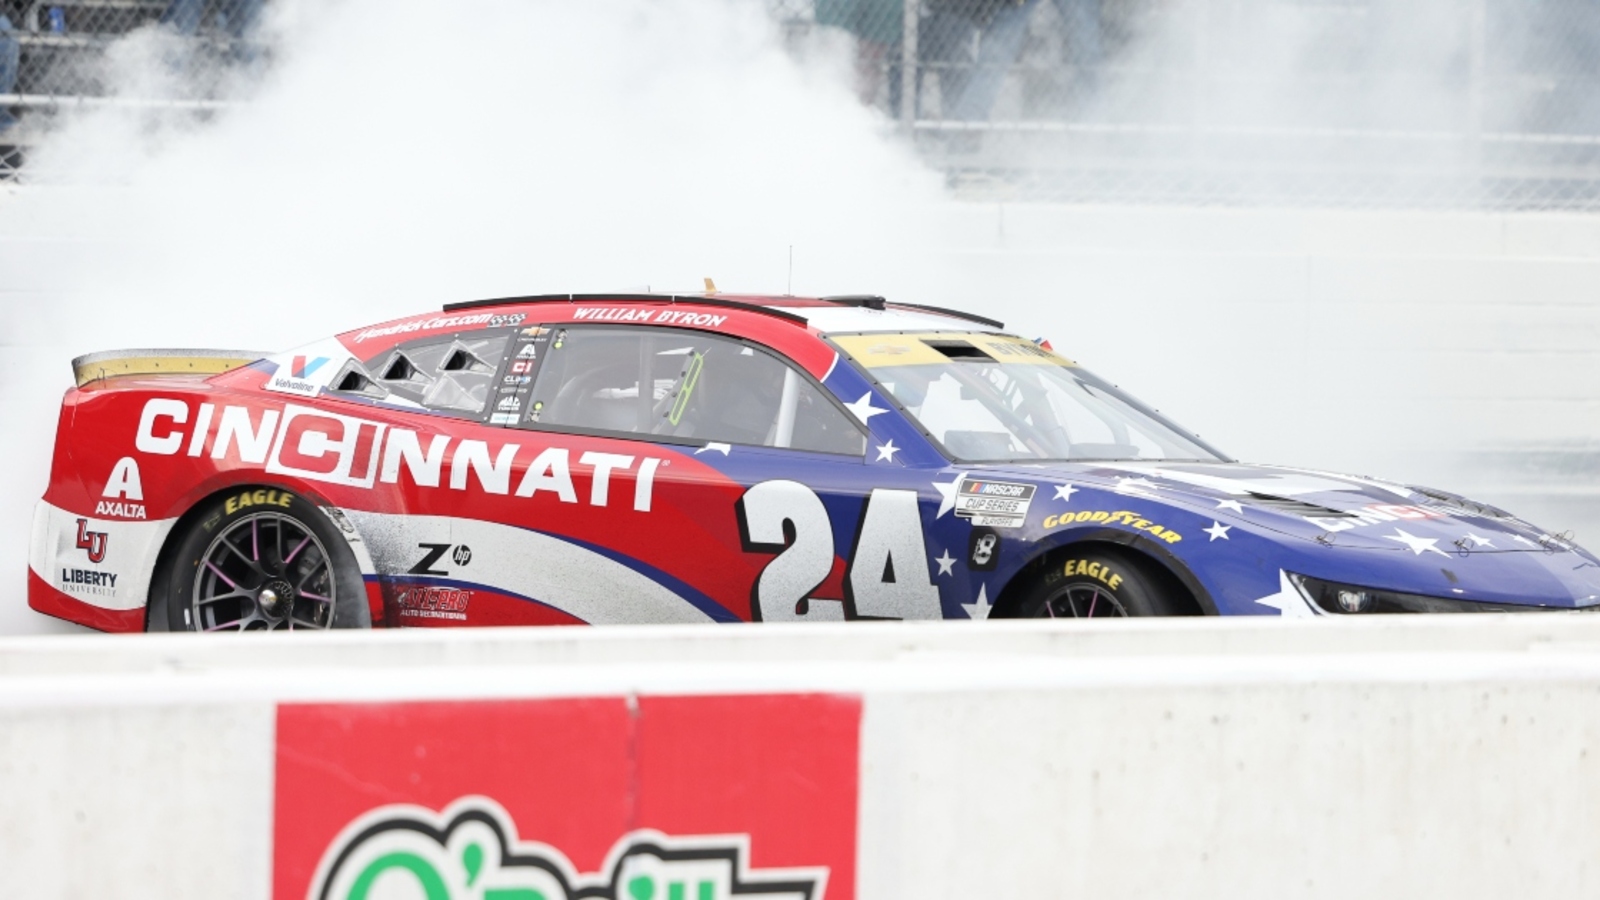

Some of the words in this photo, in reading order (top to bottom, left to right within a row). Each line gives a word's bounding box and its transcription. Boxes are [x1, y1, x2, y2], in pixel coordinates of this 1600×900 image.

[573, 308, 655, 321] WILLIAM
[654, 310, 728, 327] BYRON
[275, 378, 314, 392] Valvoline
[135, 398, 661, 512] CINCINNATI
[982, 484, 1025, 496] NASCAR
[95, 501, 147, 519] AXALTA
[225, 490, 294, 516] EAGLE
[965, 498, 986, 509] CUP
[985, 500, 1020, 512] SERIES
[1043, 511, 1183, 544] GOODYEAR
[407, 543, 452, 576] Z
[453, 544, 472, 567] hp
[736, 480, 943, 622] 24
[62, 568, 118, 588] LIBERTY
[1064, 559, 1124, 590] EAGLE
[62, 584, 117, 598] UNIVERSITY
